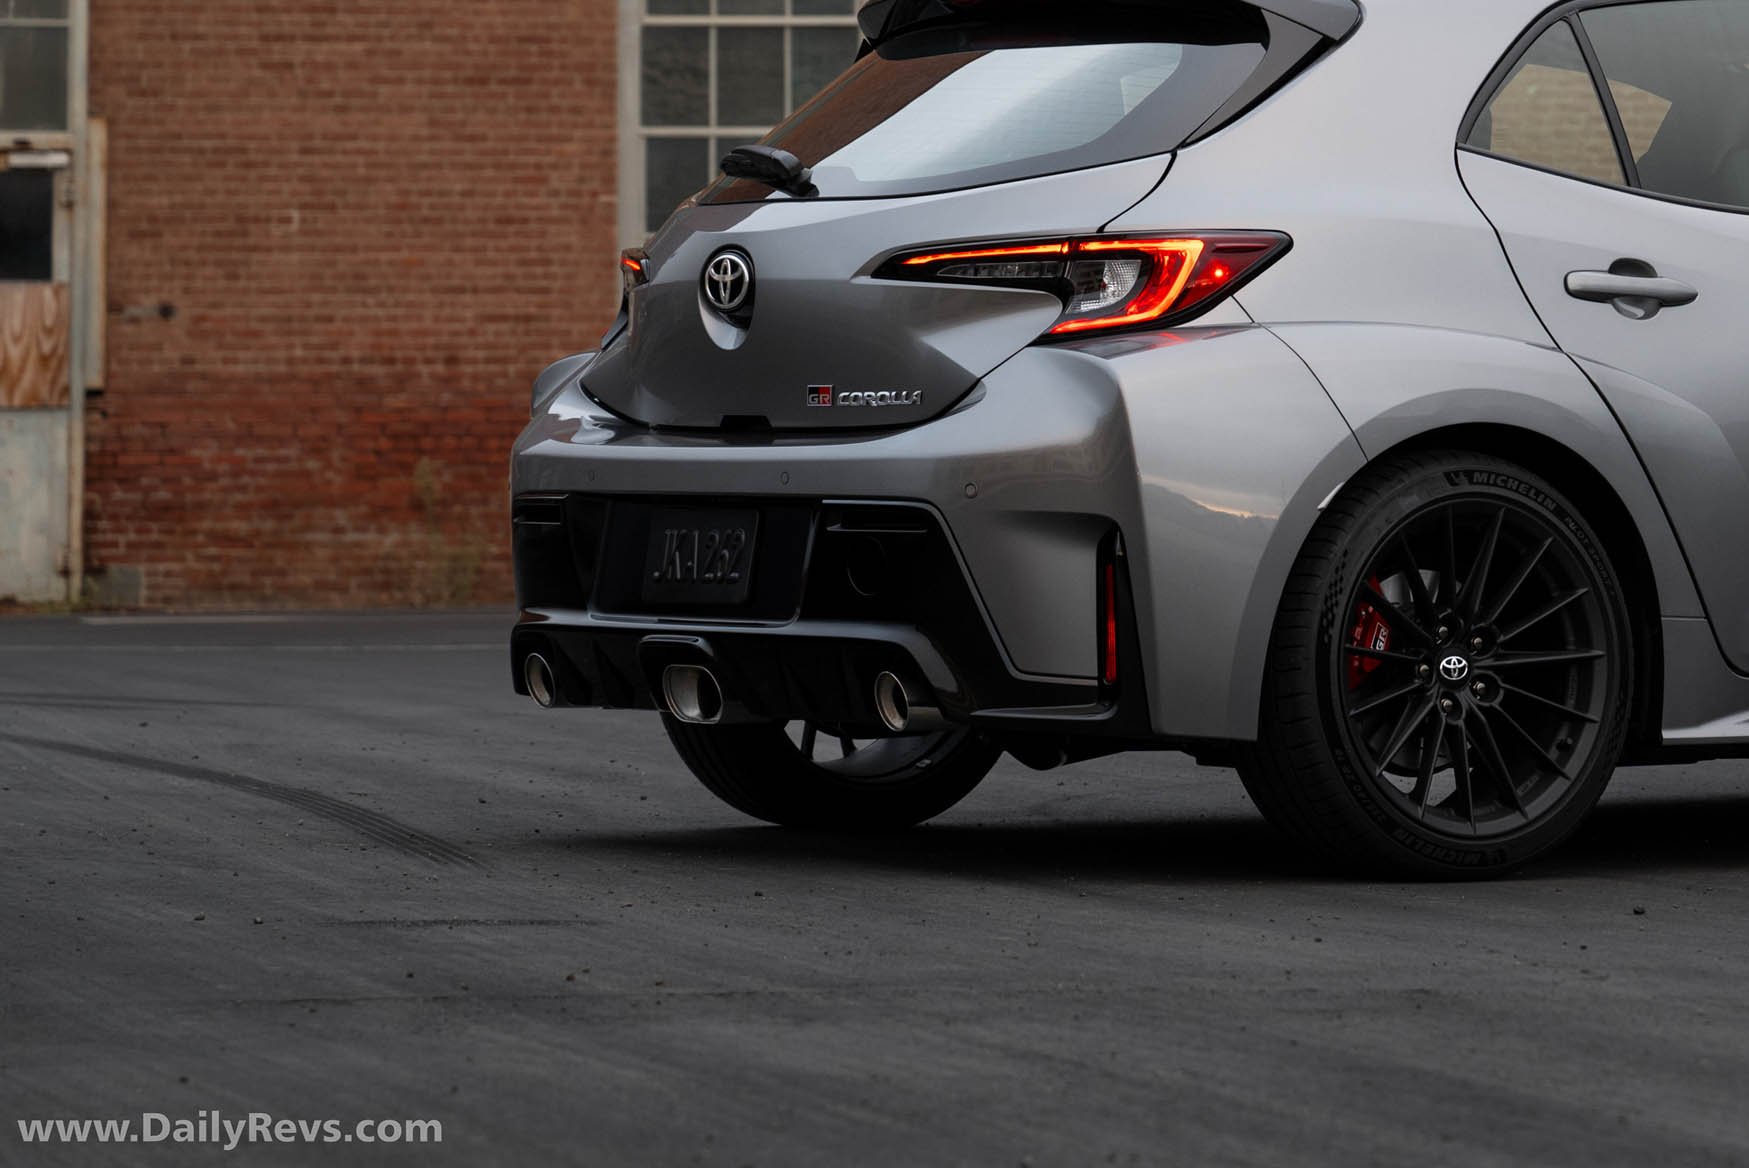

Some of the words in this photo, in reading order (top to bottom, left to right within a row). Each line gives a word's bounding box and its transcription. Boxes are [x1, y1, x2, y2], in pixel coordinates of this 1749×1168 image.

[808, 393, 830, 404] GR
[838, 390, 922, 407] COROLLA
[1472, 471, 1558, 512] MICHELIN
